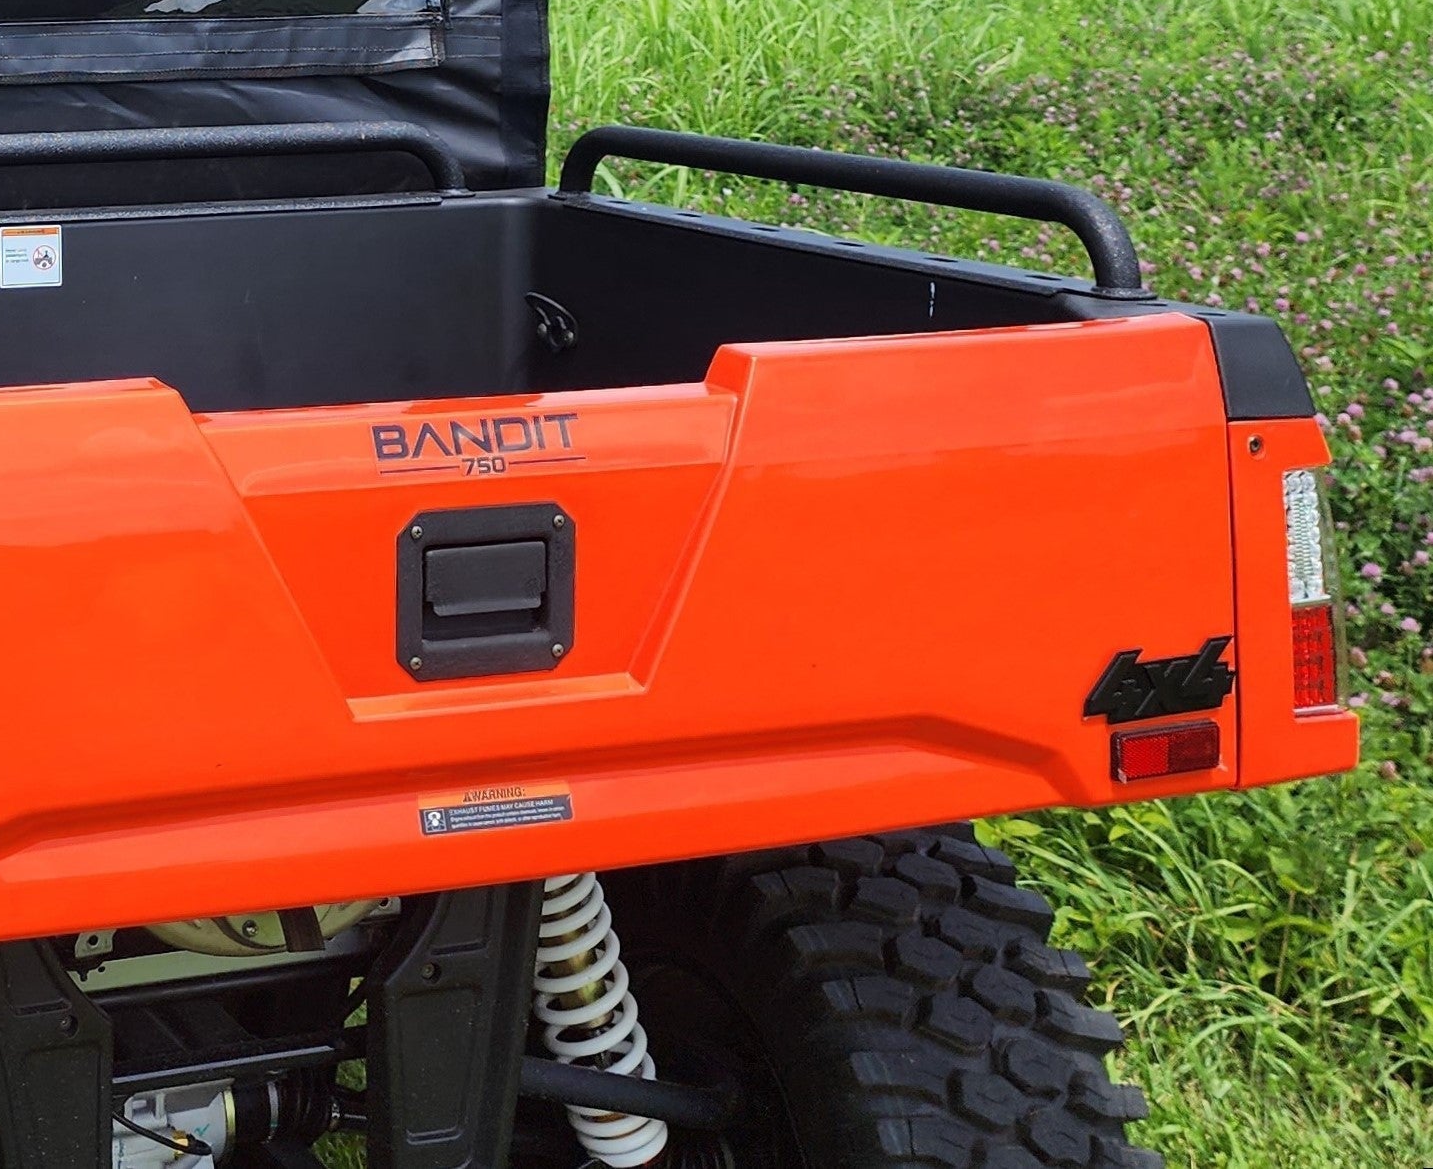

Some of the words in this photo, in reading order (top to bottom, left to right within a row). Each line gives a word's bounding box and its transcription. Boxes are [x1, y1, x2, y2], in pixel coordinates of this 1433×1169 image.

[372, 413, 578, 461] BANDIT
[461, 456, 506, 476] 750
[535, 799, 553, 808] HARM
